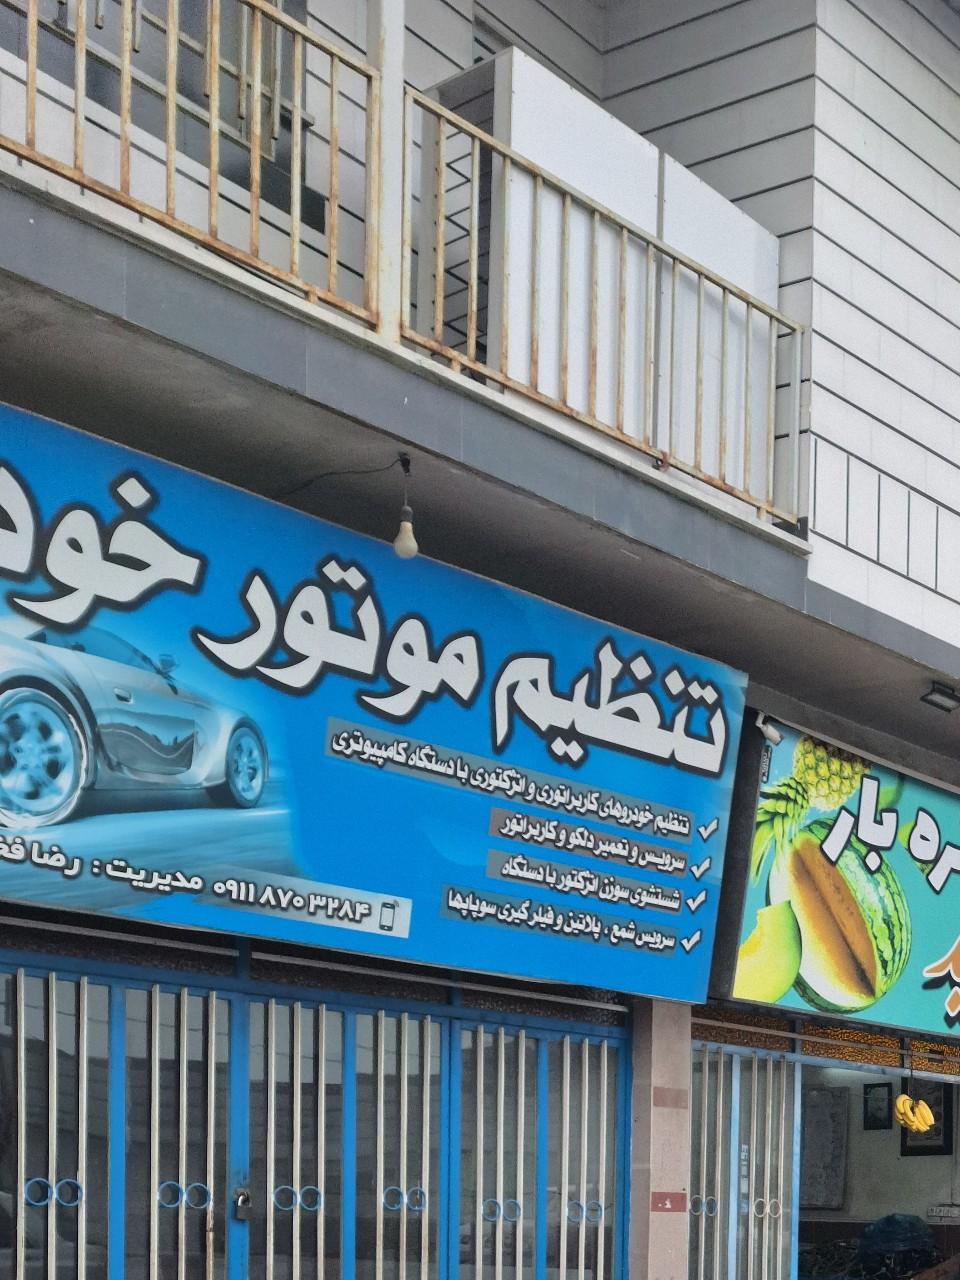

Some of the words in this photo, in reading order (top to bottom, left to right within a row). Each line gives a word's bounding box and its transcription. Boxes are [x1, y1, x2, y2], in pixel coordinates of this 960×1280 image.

[197, 558, 482, 716] موتور
[494, 641, 729, 776] تنظیم
[331, 730, 409, 766] کامپیوتری
[407, 744, 455, 775] دستگاه
[456, 758, 469, 781] با
[525, 782, 535, 800] و
[535, 785, 600, 812] کاربراتوری
[499, 813, 558, 842] کاربراتور
[653, 812, 690, 835] تنظیم
[822, 776, 898, 872] بار
[557, 830, 567, 847] و
[567, 826, 595, 849] دلکو
[595, 838, 629, 856] تعمیر
[31, 841, 81, 877] رضا
[628, 846, 638, 862] و
[638, 850, 686, 870] سرویس
[501, 855, 545, 883] دستگاه
[545, 868, 557, 888] با
[599, 877, 630, 901] سوزن
[630, 884, 681, 909] شستشوی
[563, 912, 601, 939] پلاتین
[634, 930, 675, 949] سرویس
